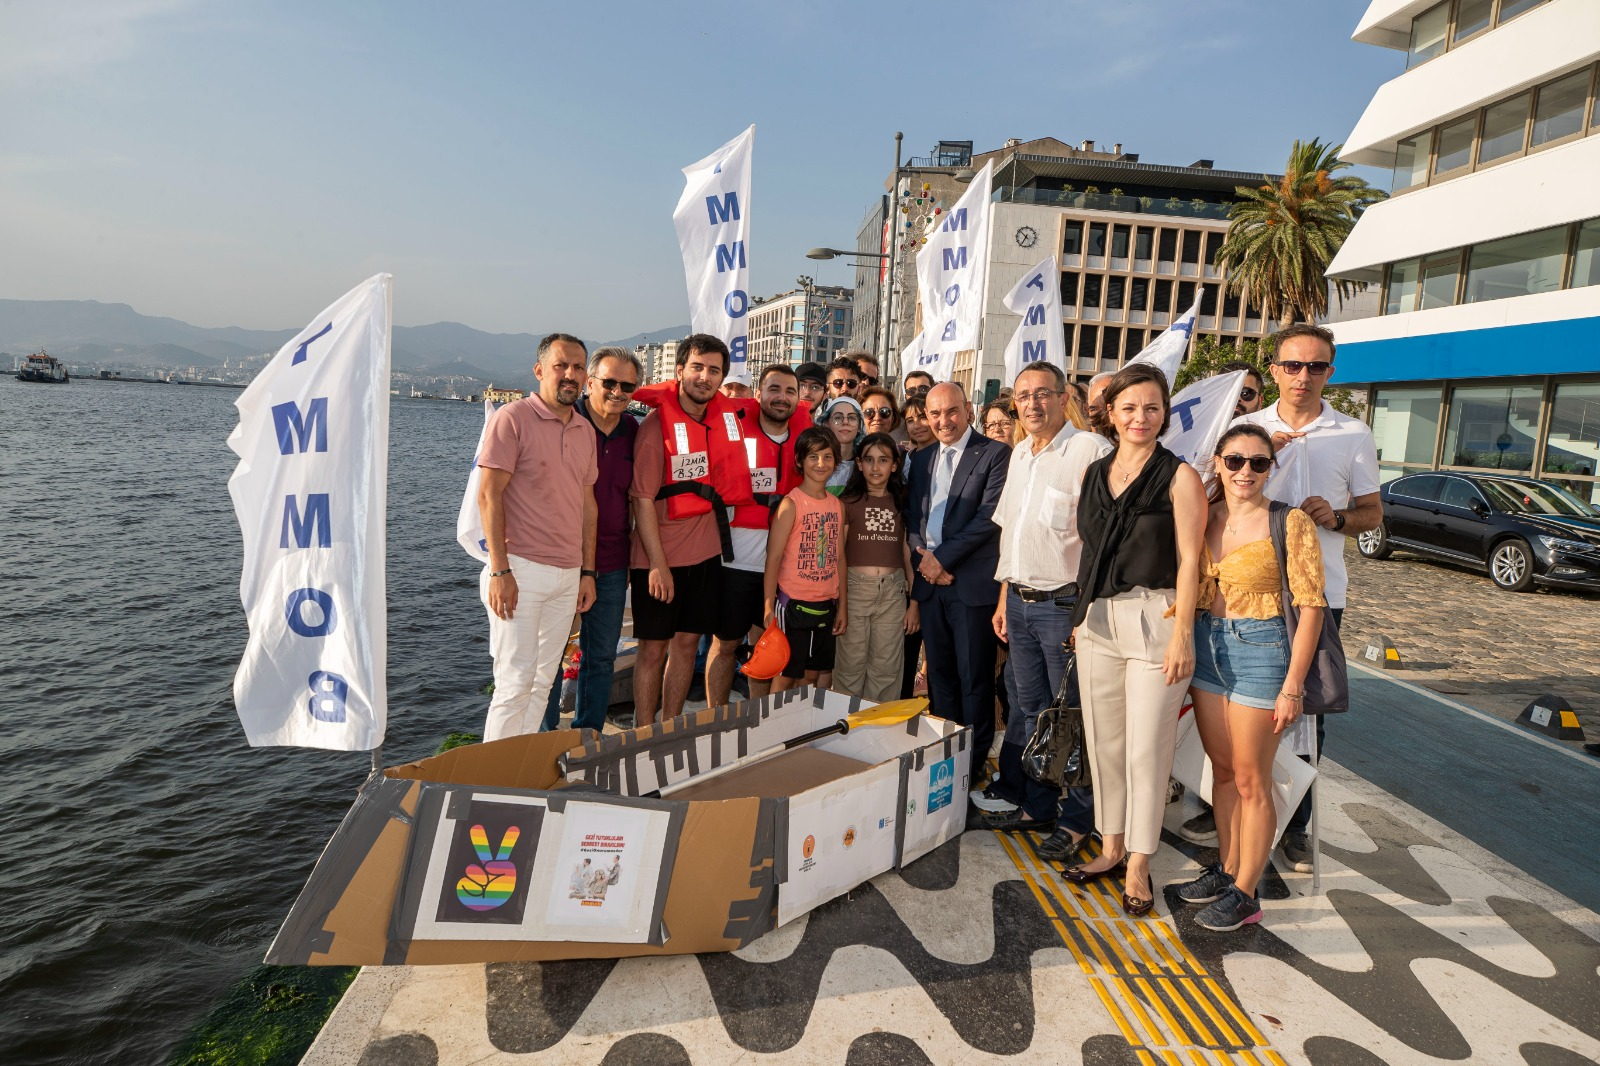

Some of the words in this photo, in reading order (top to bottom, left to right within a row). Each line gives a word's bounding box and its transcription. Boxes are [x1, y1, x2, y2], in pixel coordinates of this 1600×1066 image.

[1023, 272, 1047, 363] TMM
[681, 454, 707, 467] İZMİR
[750, 470, 765, 478] MİR
[752, 477, 772, 489] .Ş.B
[800, 531, 816, 542] THE
[857, 533, 869, 541] Jeu
[797, 560, 815, 570] LIFE
